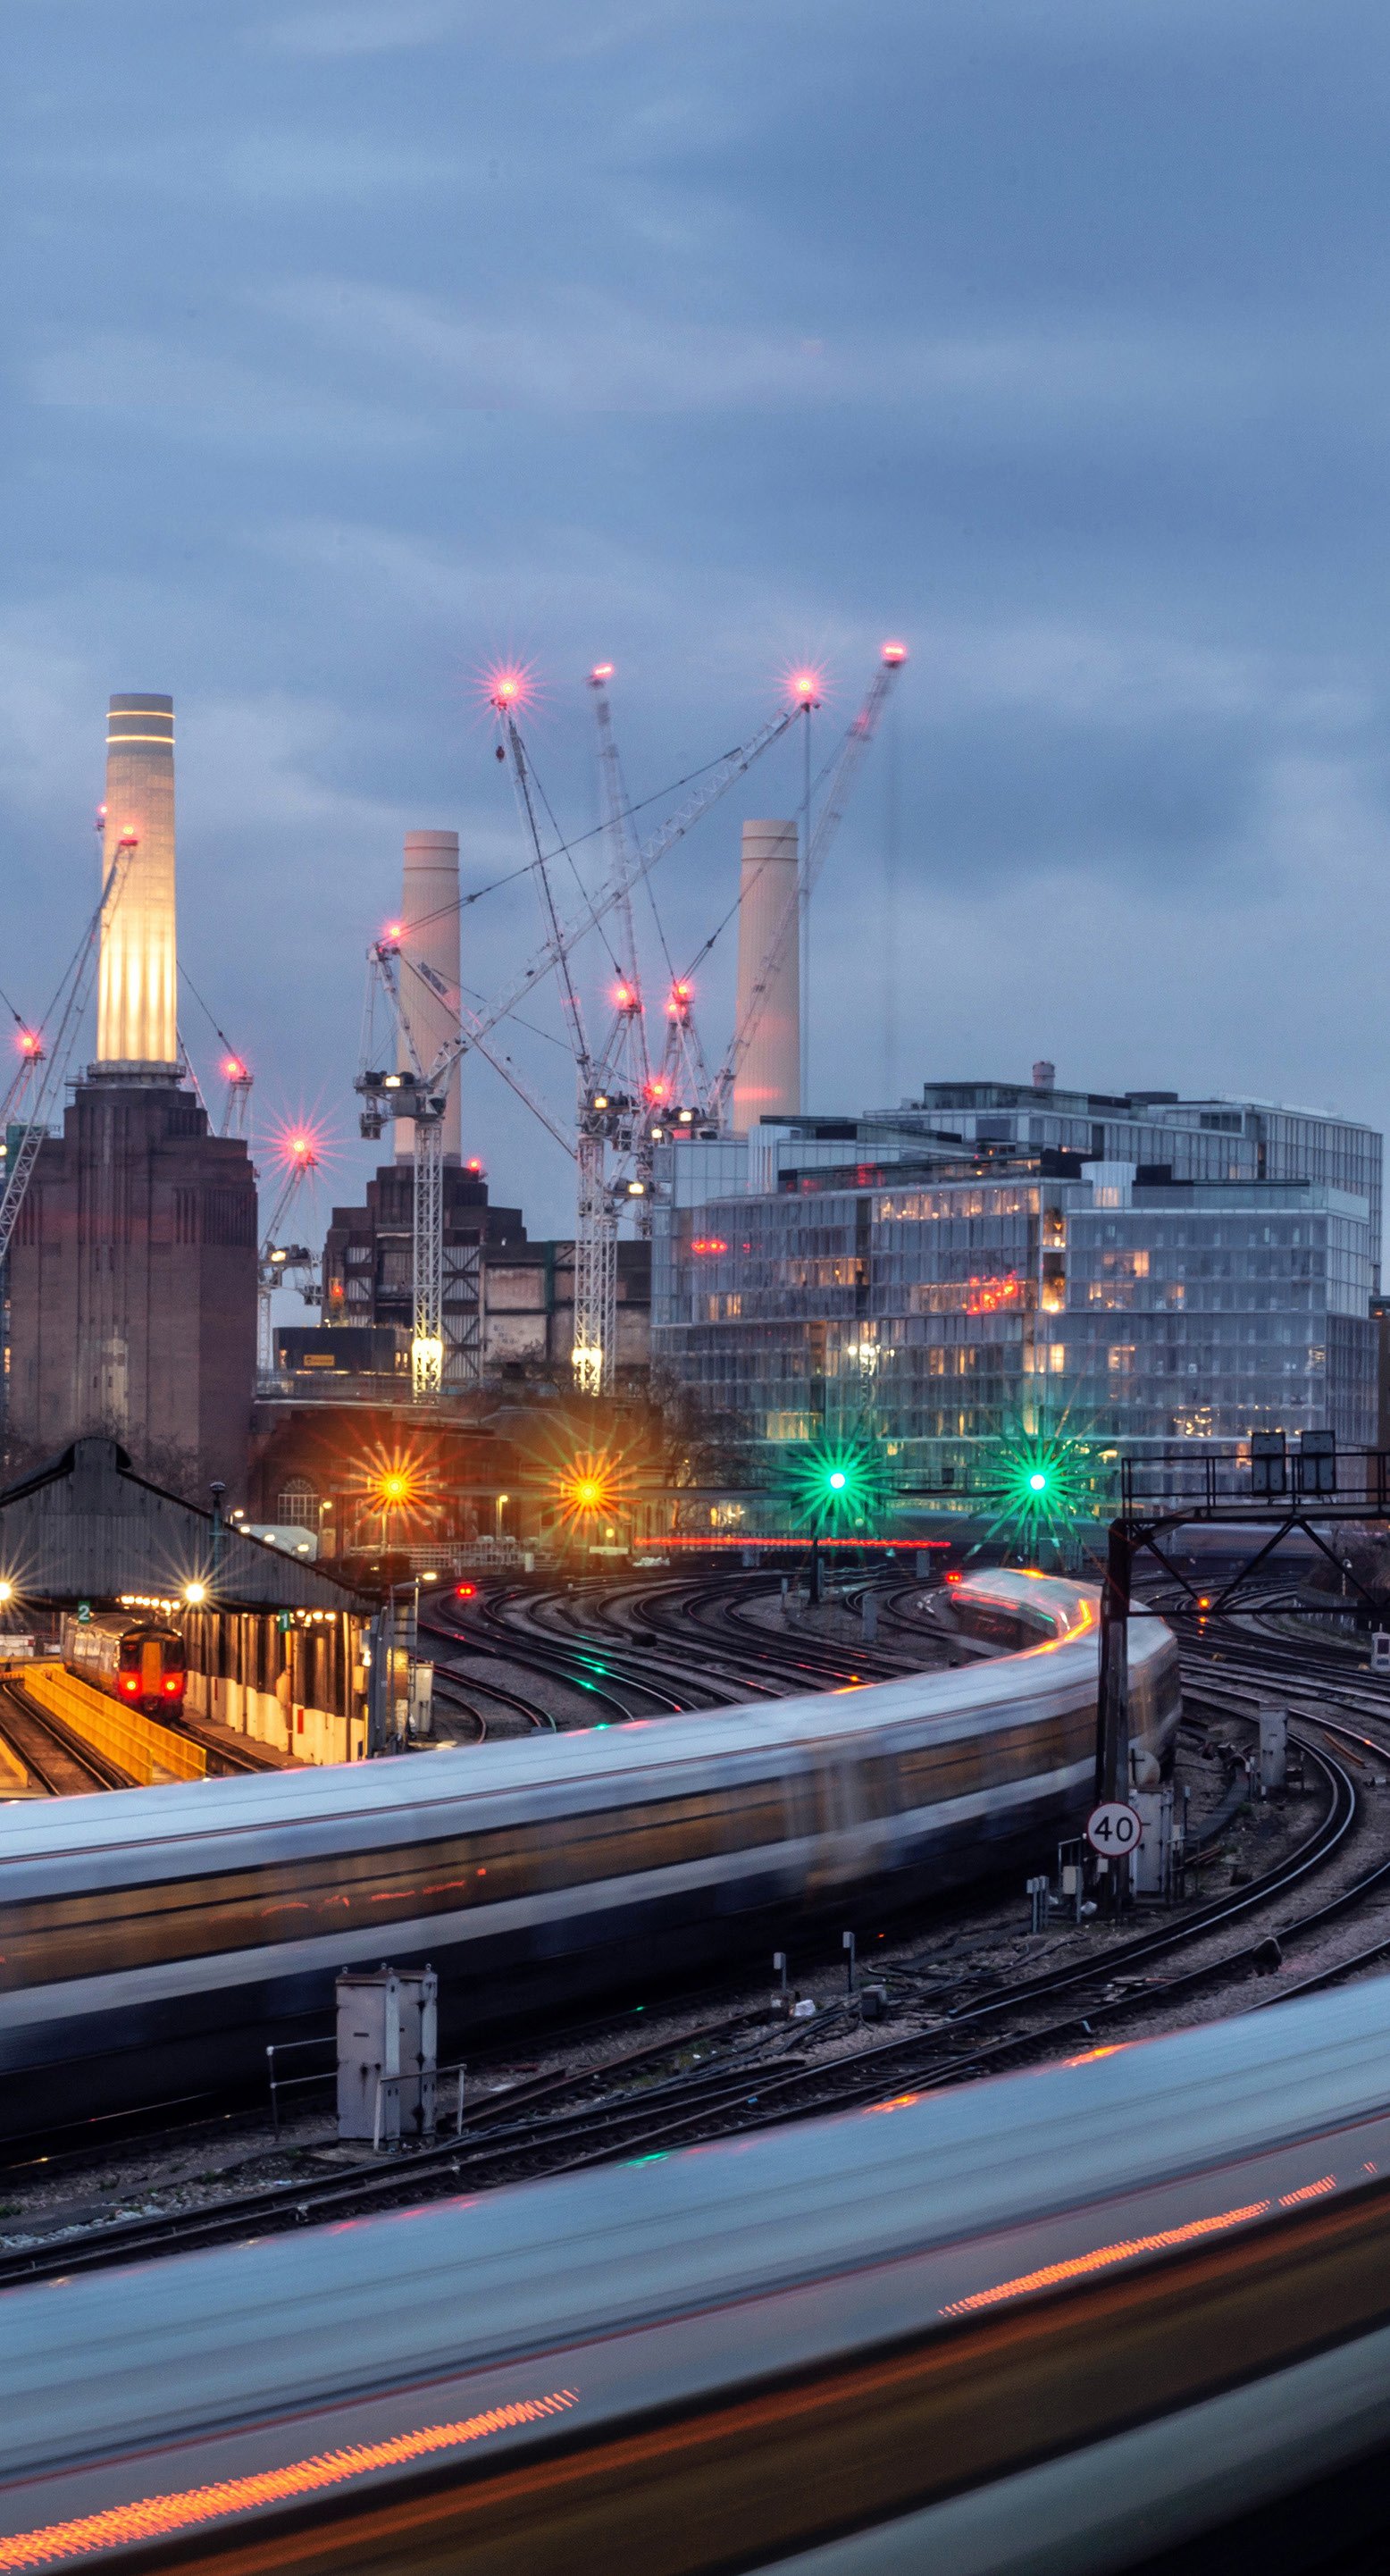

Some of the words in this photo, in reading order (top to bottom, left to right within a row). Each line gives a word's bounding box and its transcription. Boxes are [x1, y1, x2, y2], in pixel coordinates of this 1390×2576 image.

[79, 1605, 89, 1620] 2
[281, 1614, 288, 1628] 1
[1094, 1816, 1133, 1842] 40
